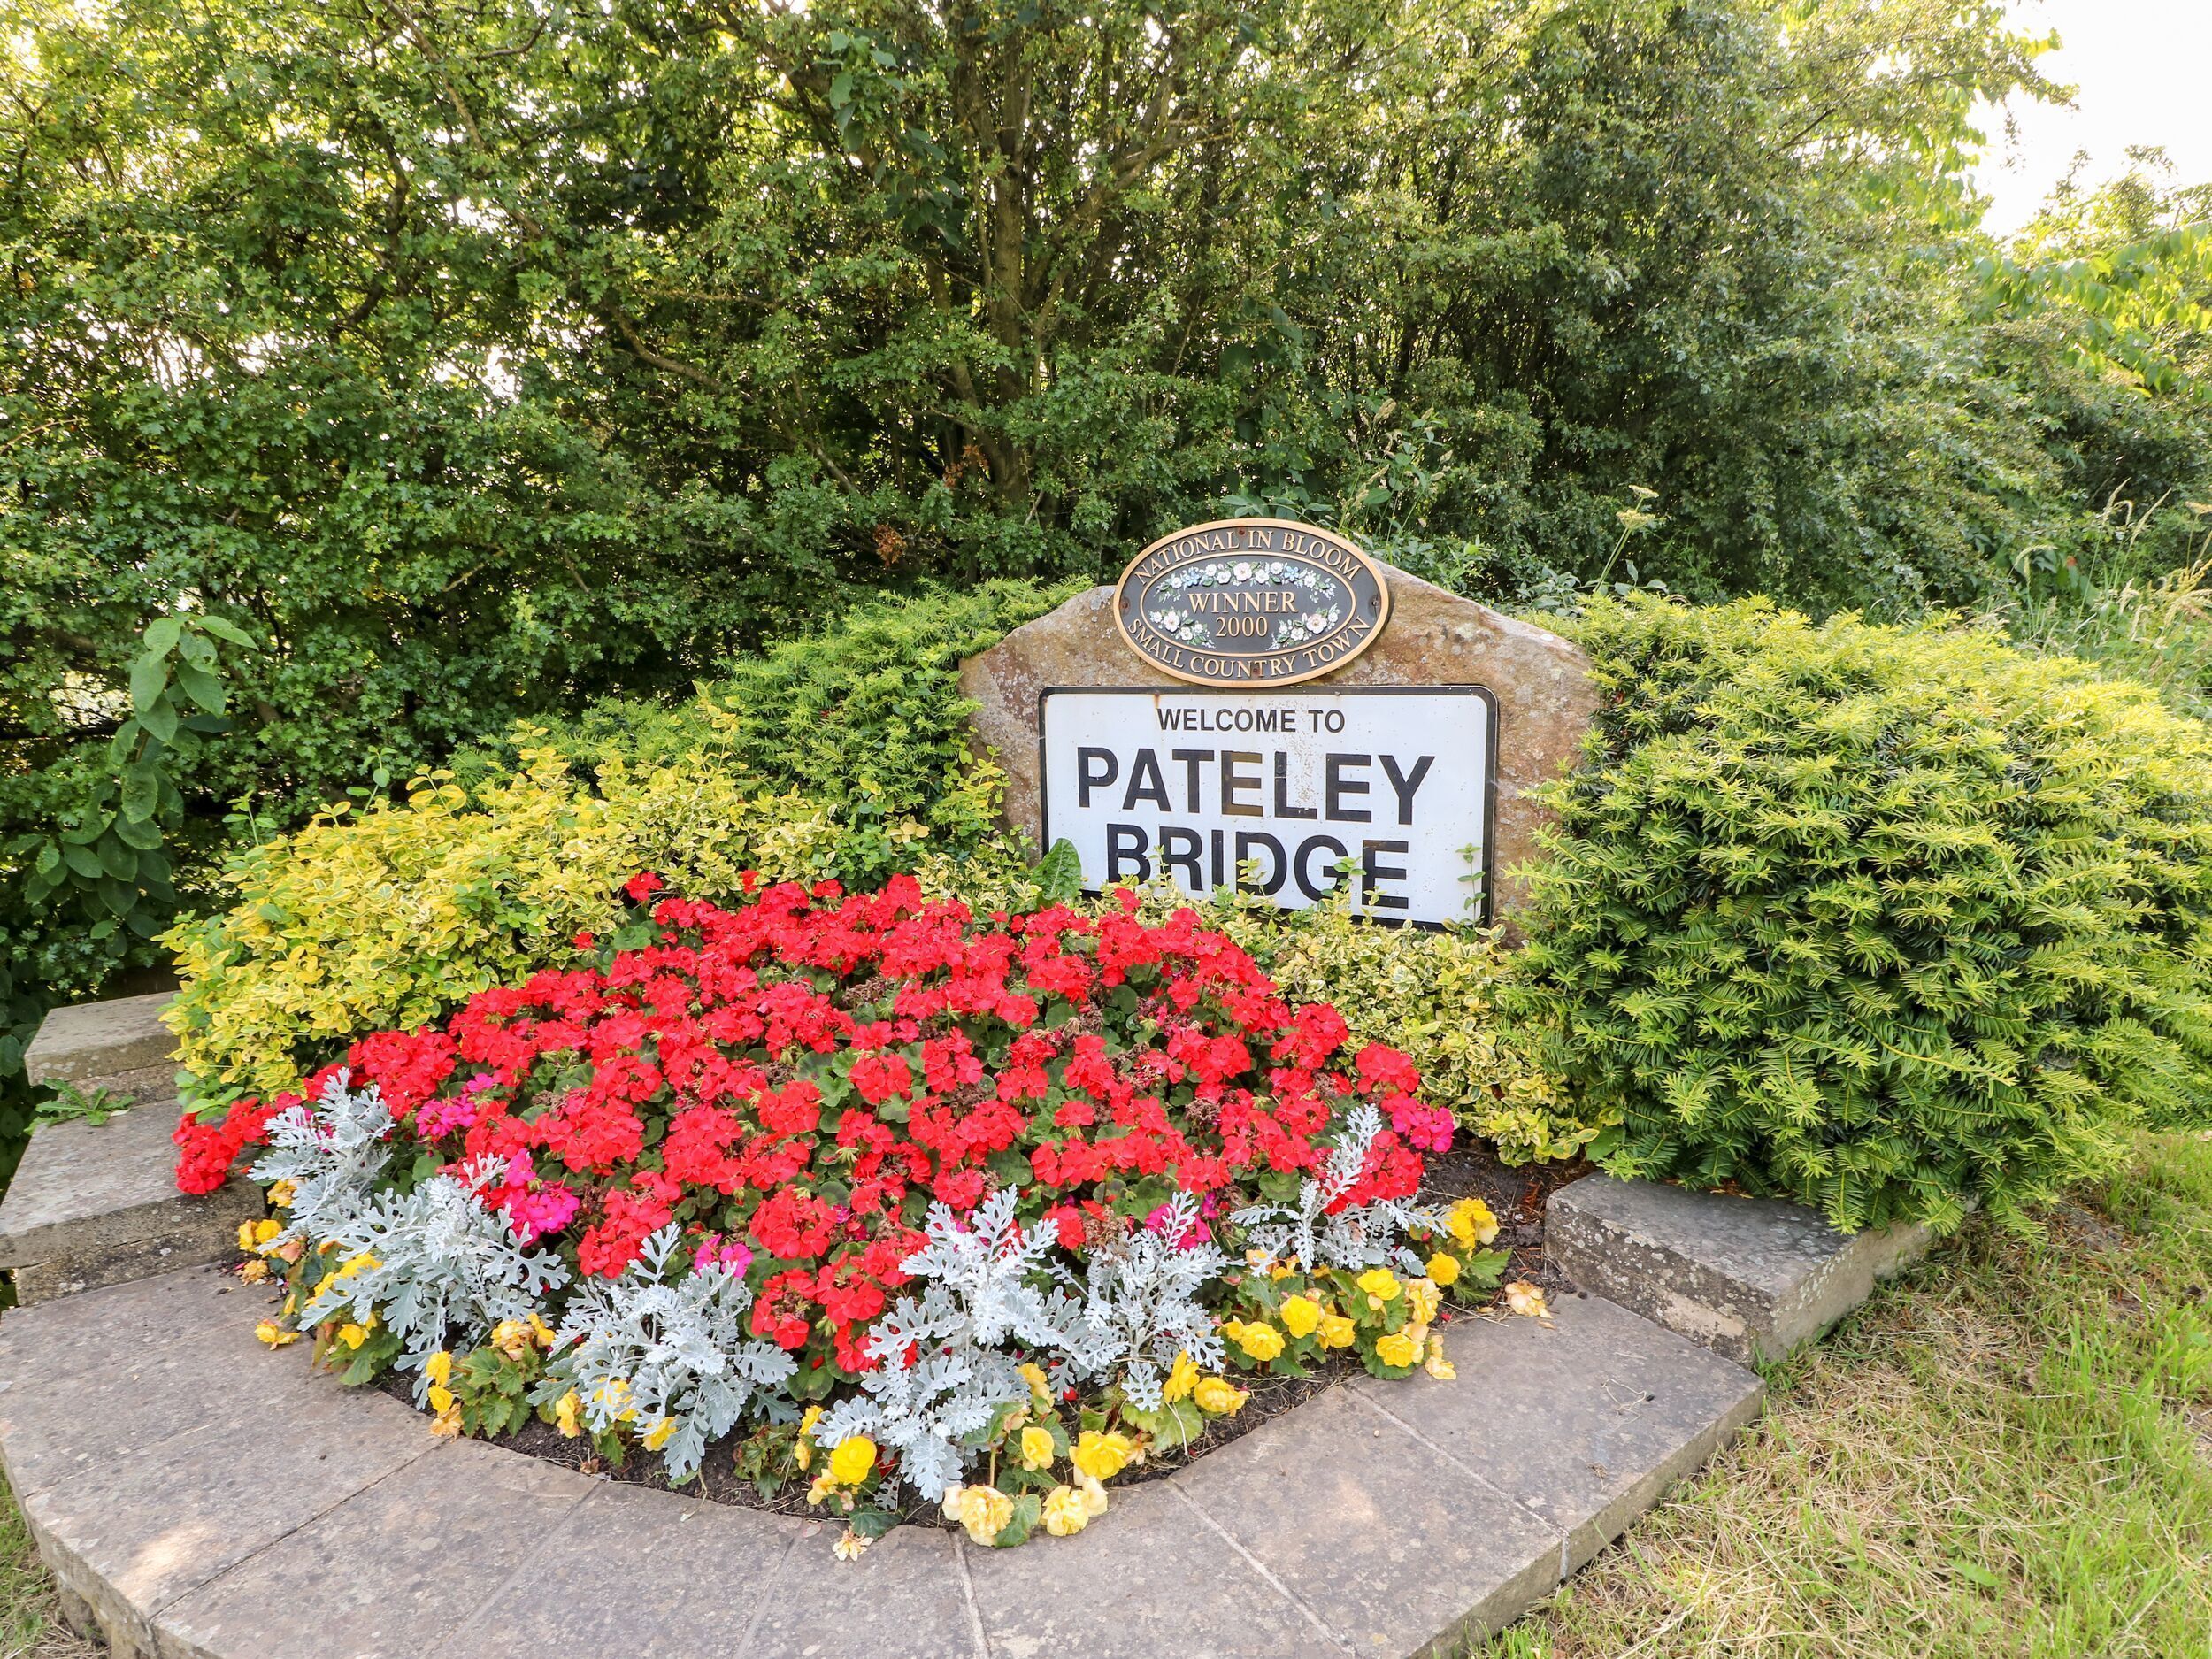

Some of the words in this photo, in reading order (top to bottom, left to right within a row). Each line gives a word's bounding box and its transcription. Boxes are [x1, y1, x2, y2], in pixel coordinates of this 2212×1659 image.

[1134, 530, 1240, 585] NATIONAL
[1248, 530, 1272, 549] IN
[1281, 533, 1363, 580] BLOOM
[1187, 592, 1299, 613] WINNER
[1216, 617, 1268, 638] 2000
[1128, 618, 1184, 669] SMALL
[1190, 656, 1297, 678] COUNTRY
[1302, 615, 1371, 668] TOWN
[1156, 708, 1296, 733] WELCOME
[1308, 710, 1345, 733] TO
[1077, 747, 1436, 826] PATELEY
[1107, 823, 1409, 909] BRIDGE
